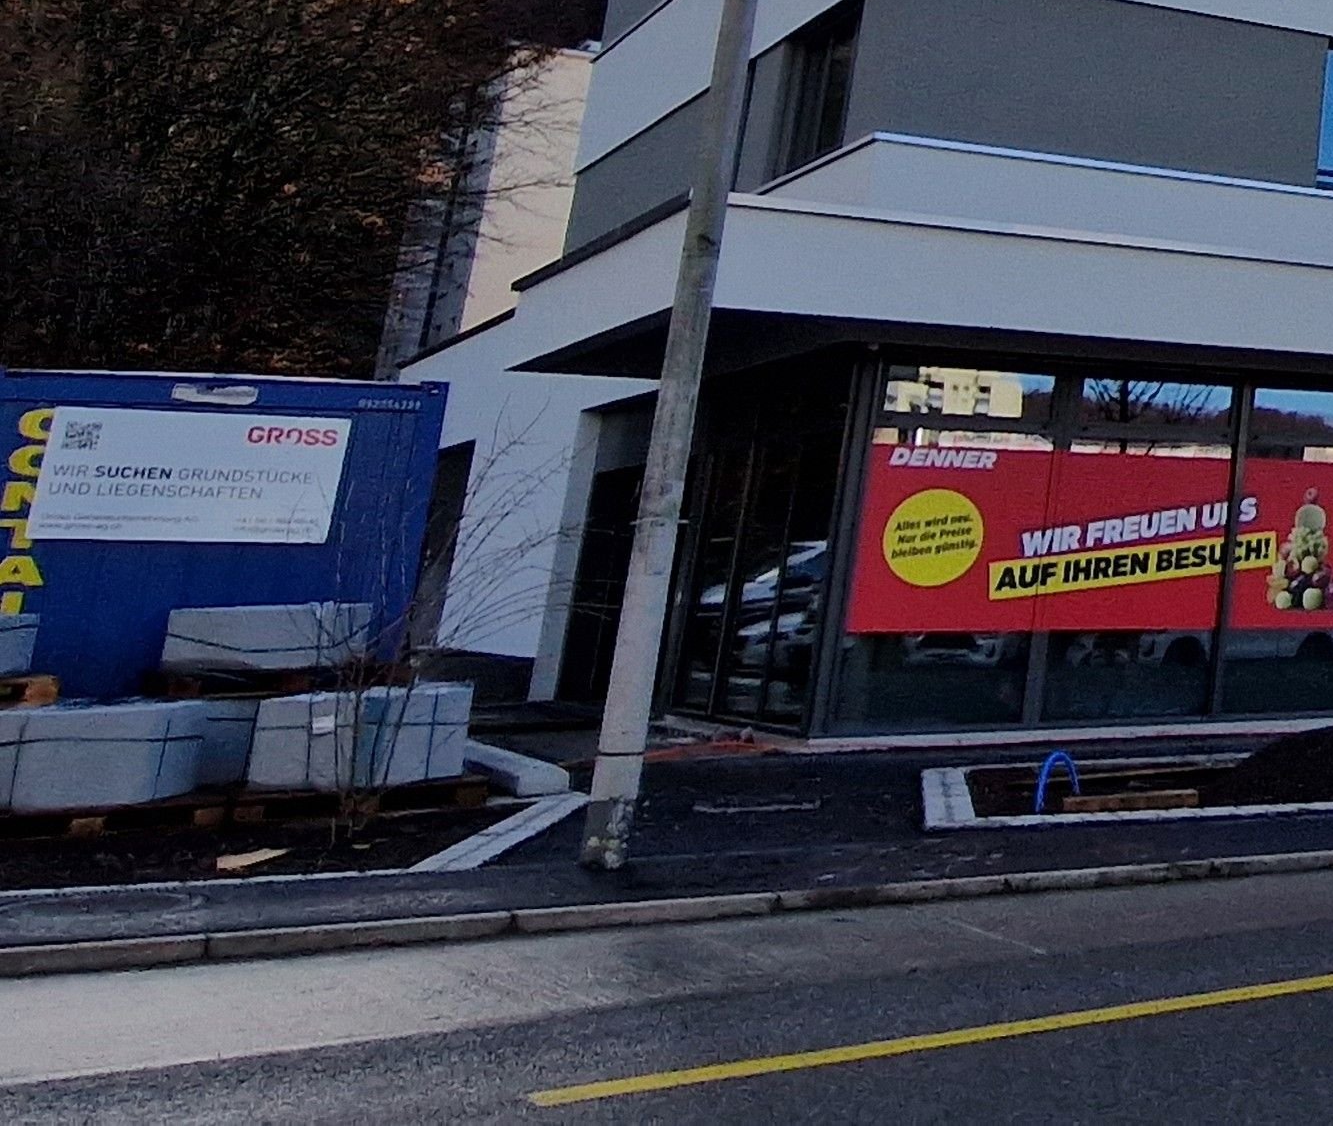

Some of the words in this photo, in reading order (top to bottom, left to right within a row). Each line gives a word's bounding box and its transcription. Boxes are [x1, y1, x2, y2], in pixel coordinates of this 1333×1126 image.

[246, 425, 339, 447] GROSS
[889, 446, 998, 469] DENNER
[52, 464, 88, 477] WIR
[94, 465, 173, 480] SUCHEN
[177, 466, 314, 485] GRUNDSTÜCKE
[48, 482, 91, 496] UND
[96, 482, 264, 500] LIEGENSCHAFTEN
[924, 515, 949, 529] wird
[939, 526, 973, 539] Preise
[1021, 524, 1082, 557] WIR
[1086, 506, 1197, 548] FREUEN
[995, 562, 1058, 592] AUF
[1062, 550, 1151, 584] IHREN
